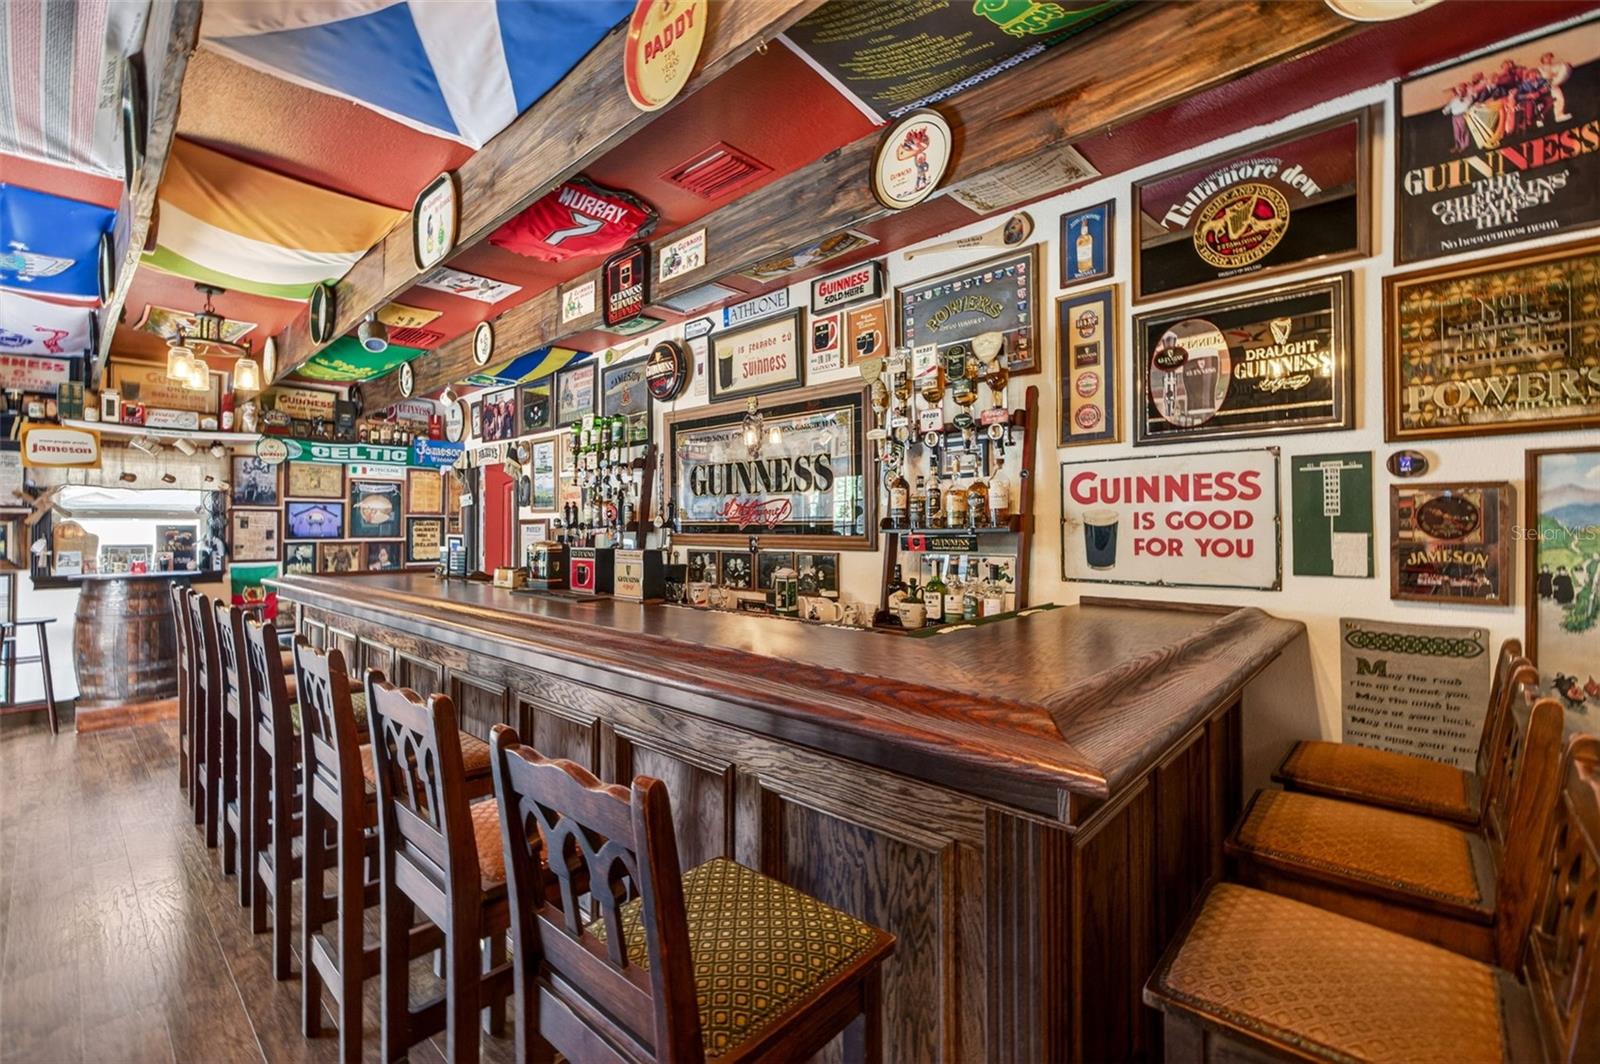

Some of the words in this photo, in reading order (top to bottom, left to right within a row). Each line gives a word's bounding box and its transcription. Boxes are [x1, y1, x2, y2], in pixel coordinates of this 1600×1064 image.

[644, 3, 697, 64] PADDY
[1404, 120, 1600, 196] GUINNESS
[557, 185, 629, 225] MURRAY
[1160, 163, 1279, 229] Tullamore
[1280, 163, 1322, 198] dew
[544, 210, 606, 247] 7
[817, 270, 870, 297] GUINNESS
[824, 291, 844, 305] SOLD
[844, 284, 865, 298] HERE
[729, 292, 786, 322] ATHLONE
[1245, 339, 1319, 361] DRAUGHT
[1234, 350, 1332, 380] GUINNESS
[1407, 366, 1600, 413] POWER'S
[279, 394, 335, 409] GUINNESS
[31, 442, 93, 454] Jameson
[310, 445, 408, 462] CELTIC
[690, 453, 834, 496] GUINNESS
[1069, 470, 1263, 505] GUINNESS
[1133, 511, 1155, 531] IS
[1165, 510, 1255, 531] GOOD
[931, 536, 971, 547] GUINNESS
[1133, 537, 1184, 557] FOR
[1193, 537, 1255, 558] YOU
[571, 550, 595, 558] GUINNESS
[1406, 550, 1489, 569] JAMESON
[1356, 657, 1403, 681] May
[1355, 692, 1384, 704] May
[1351, 715, 1380, 728] May
